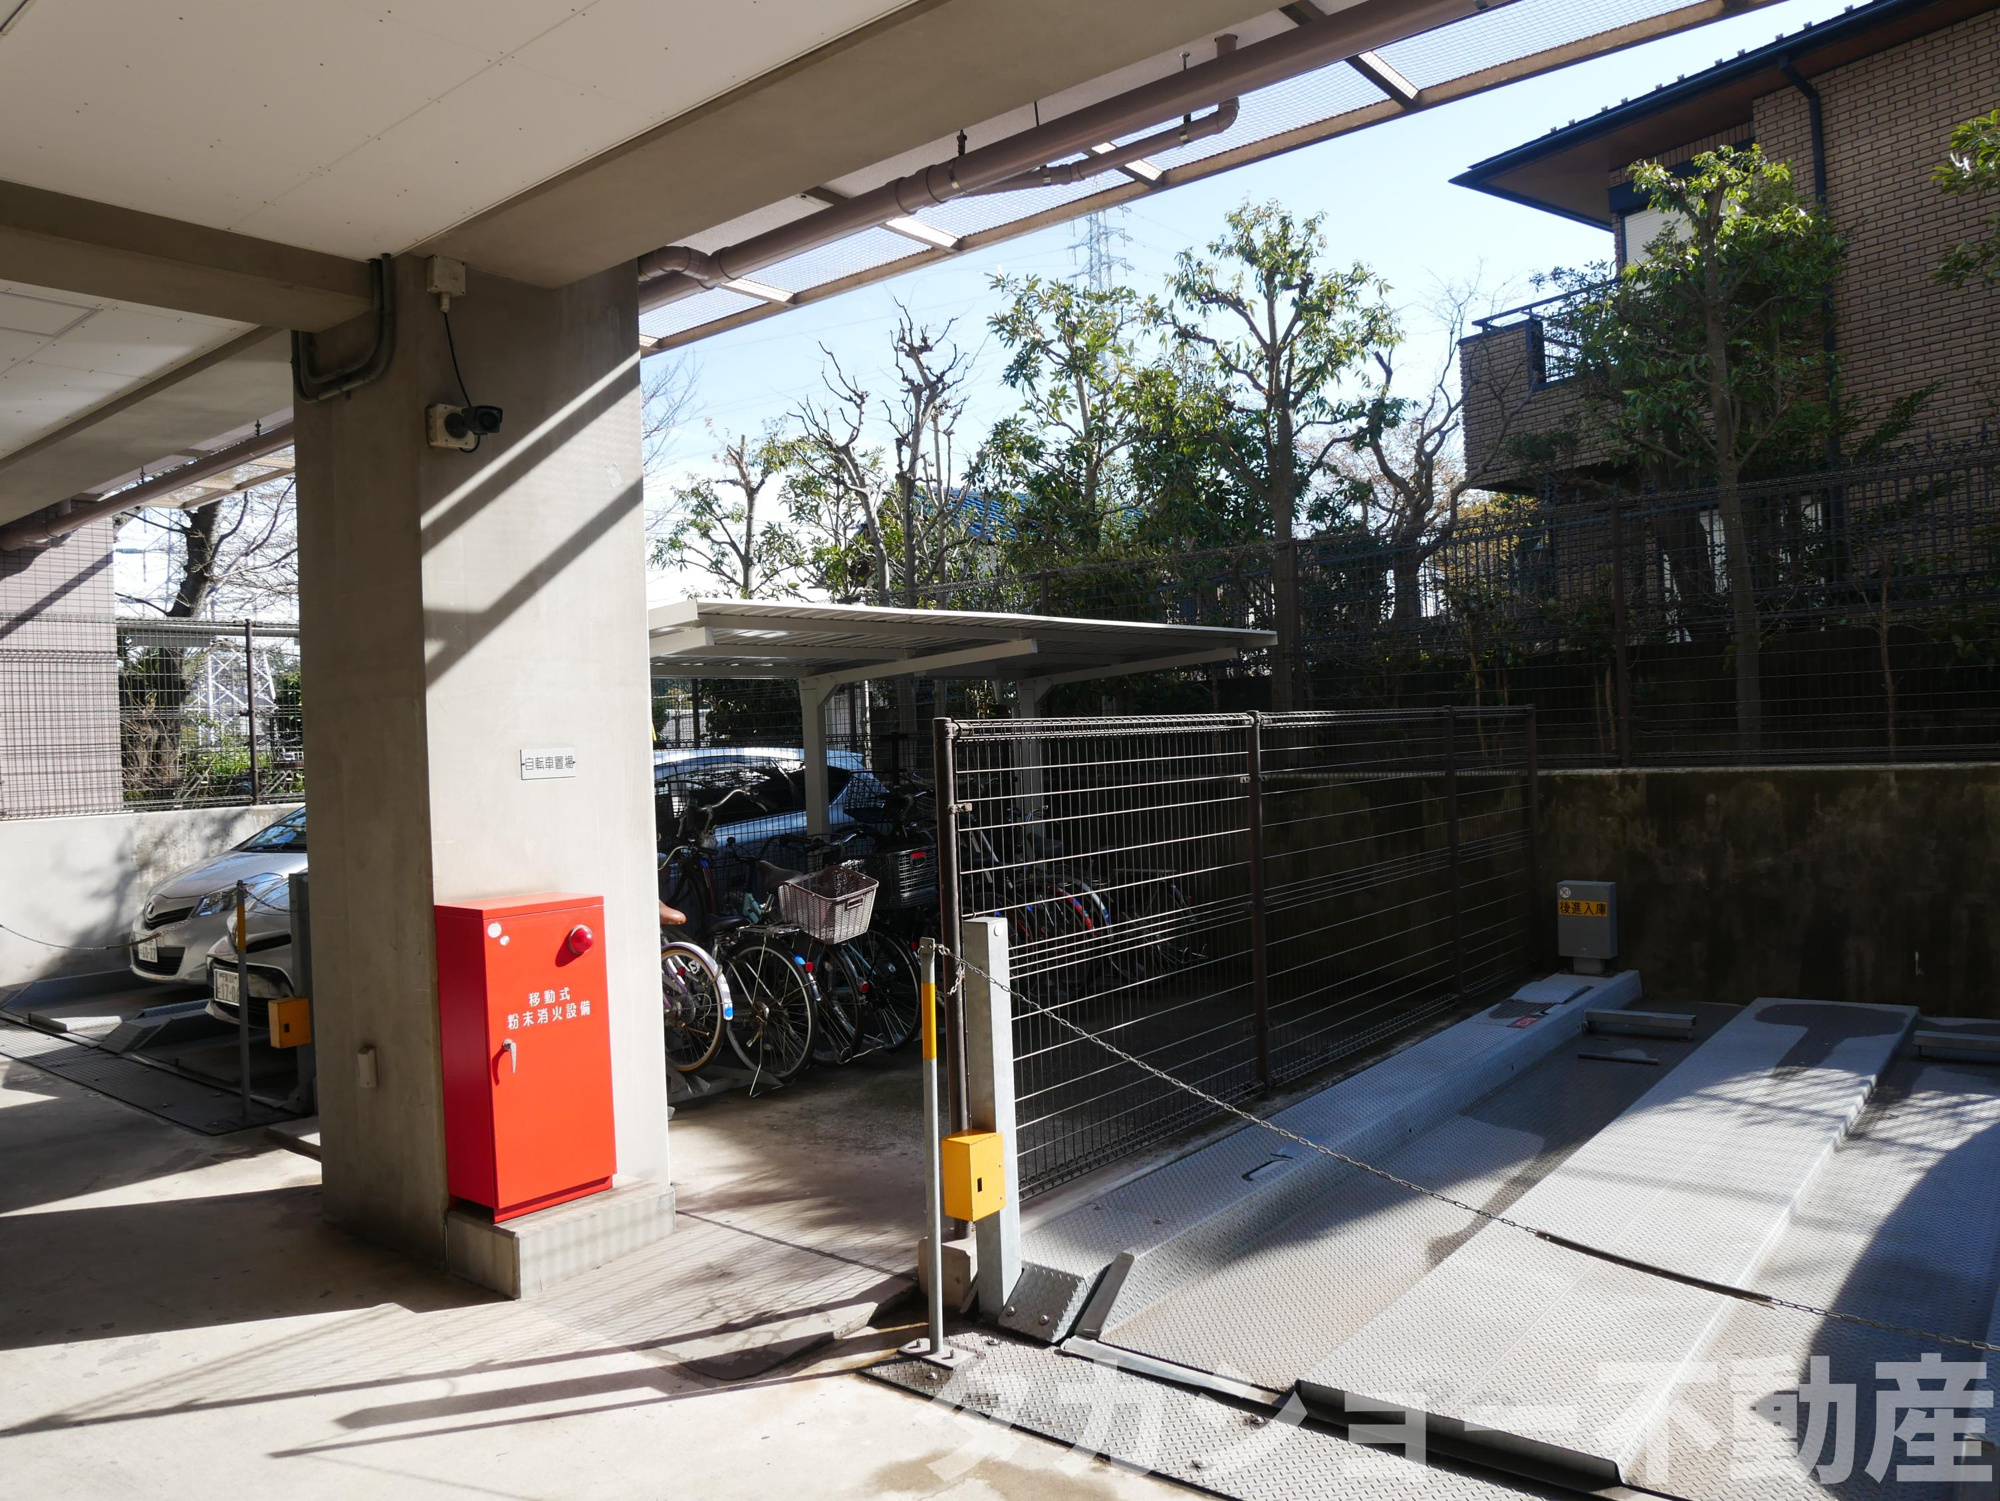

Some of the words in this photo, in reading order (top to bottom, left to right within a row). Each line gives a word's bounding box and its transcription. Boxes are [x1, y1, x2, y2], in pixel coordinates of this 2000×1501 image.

[525, 755, 574, 770] 自転車置場
[1560, 901, 1607, 916] 後進入庫
[528, 987, 571, 1007] 移動式
[507, 1000, 591, 1030] 粉末消火設備
